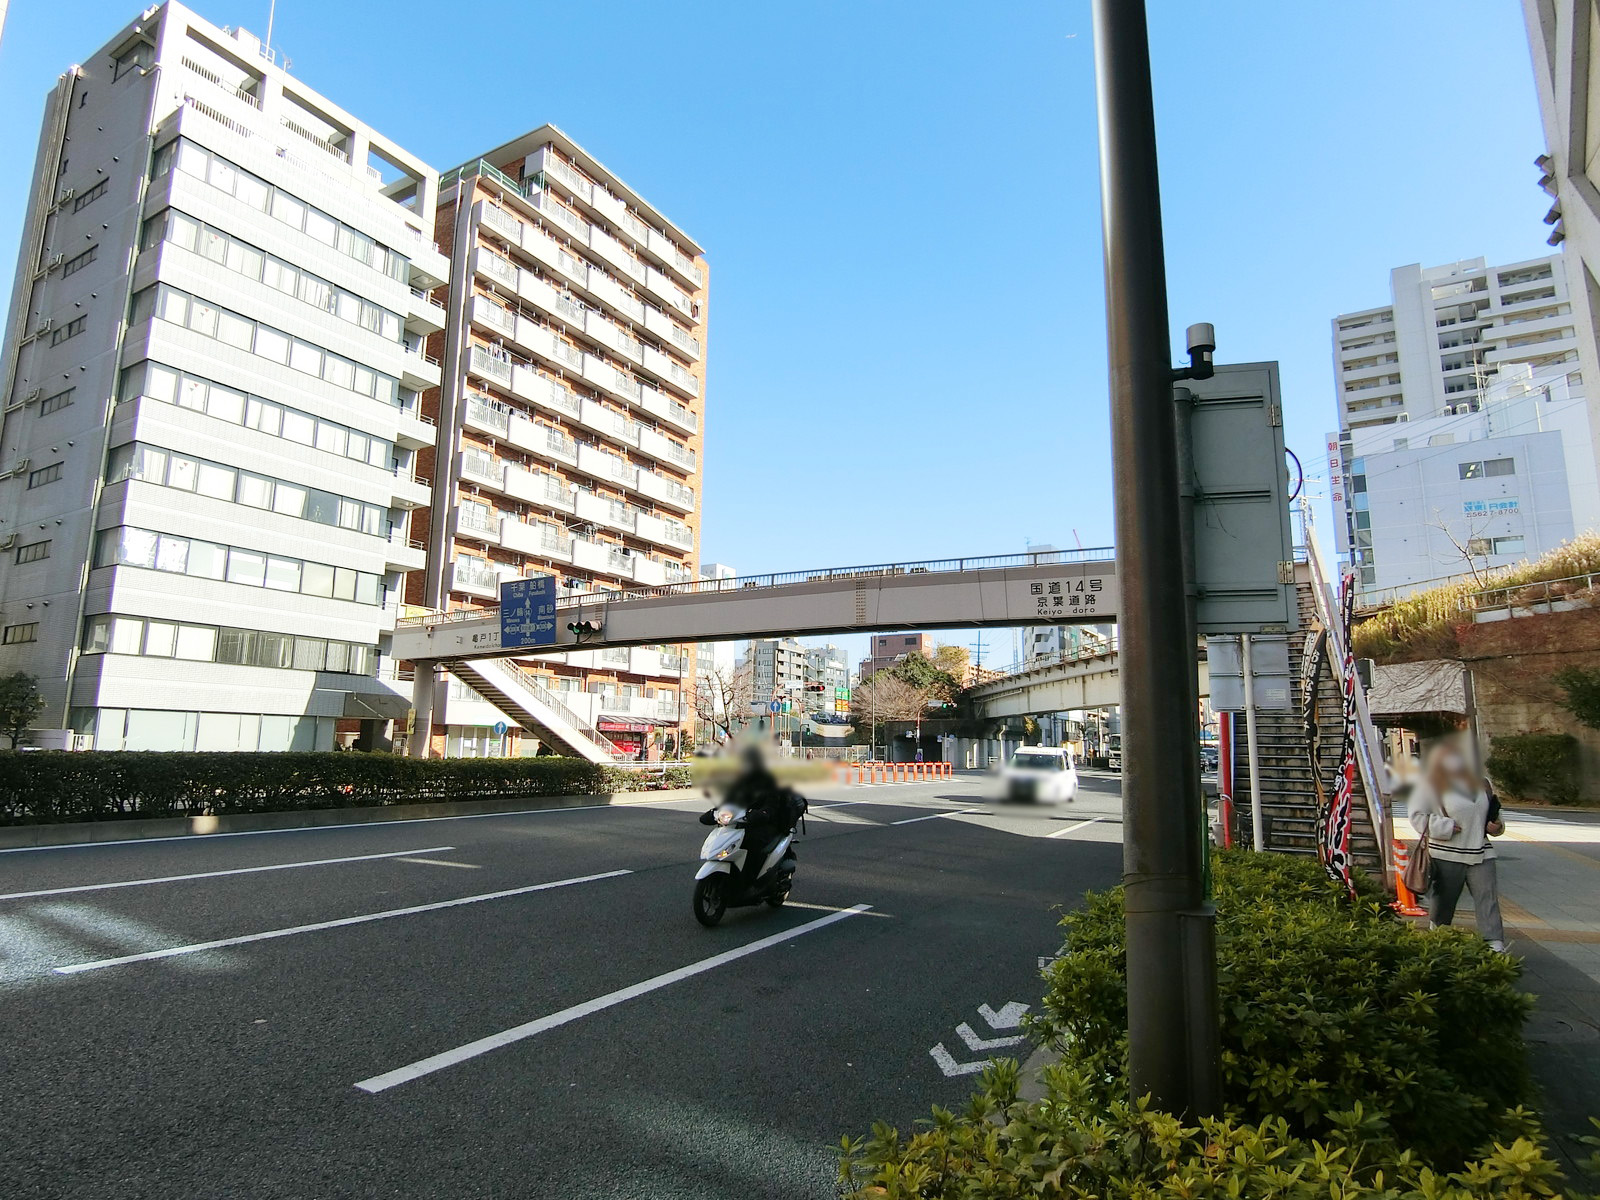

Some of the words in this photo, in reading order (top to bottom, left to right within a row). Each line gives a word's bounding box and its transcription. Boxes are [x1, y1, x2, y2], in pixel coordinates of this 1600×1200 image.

[1328, 442, 1342, 502] 朝日生命
[511, 583, 525, 592] 千葉
[529, 580, 545, 590] 船橋
[1031, 579, 1103, 596] 国道14号
[1037, 594, 1096, 608] 京葉道路
[539, 604, 554, 615] 南砂
